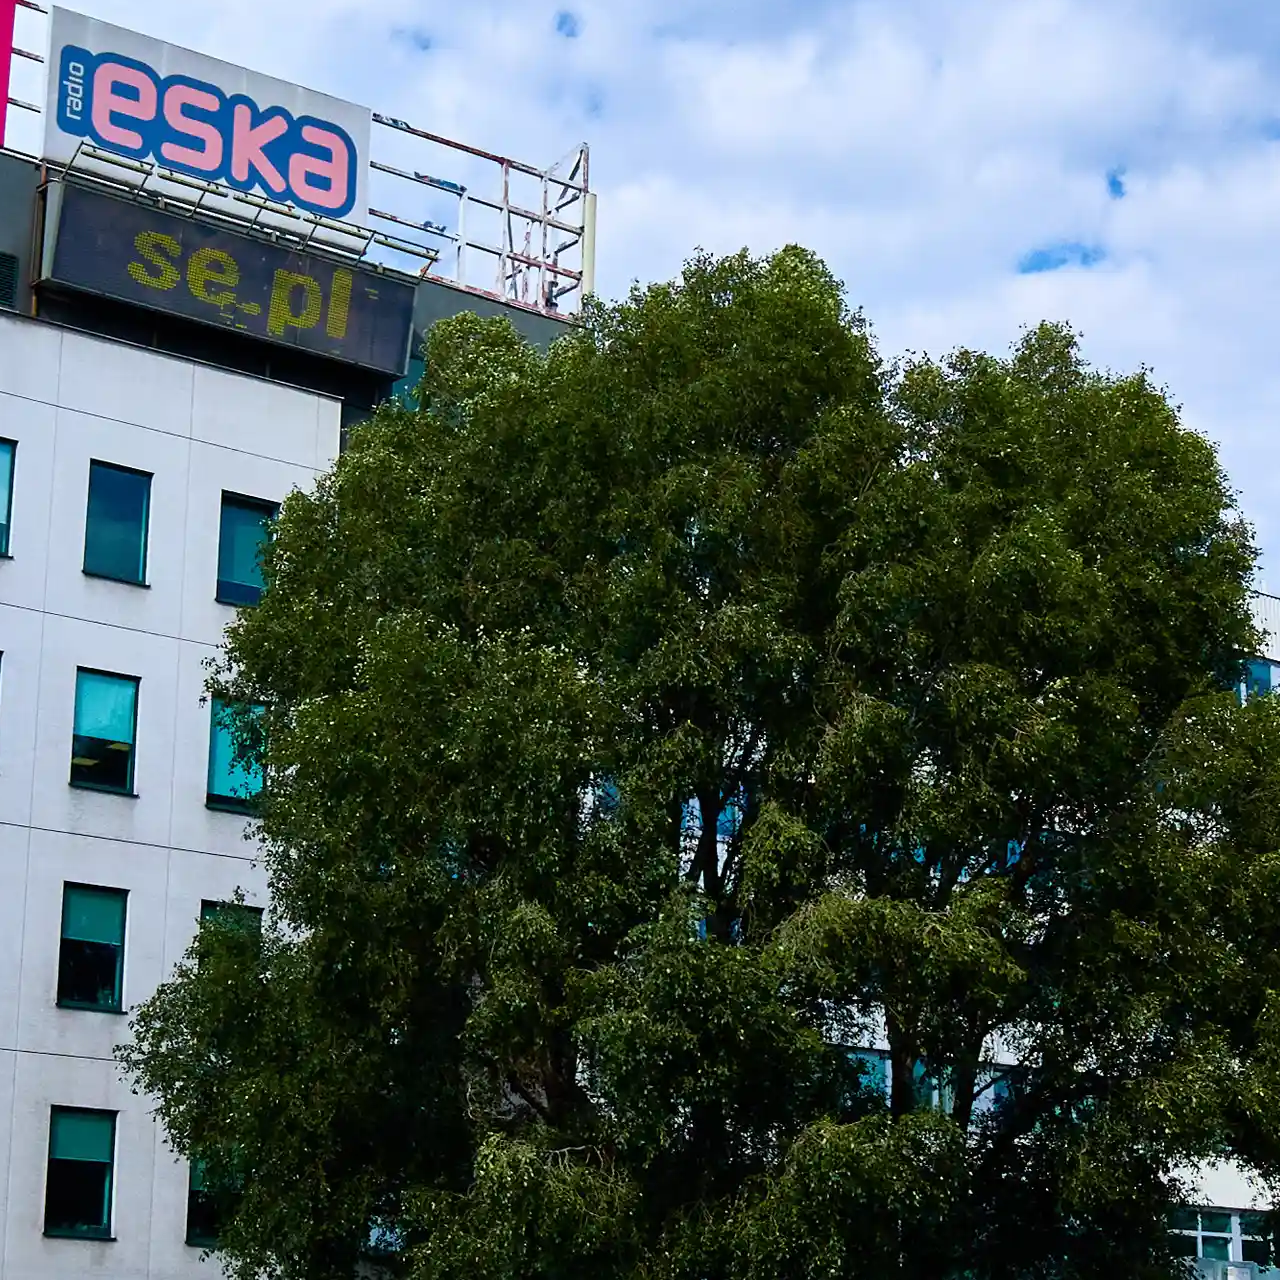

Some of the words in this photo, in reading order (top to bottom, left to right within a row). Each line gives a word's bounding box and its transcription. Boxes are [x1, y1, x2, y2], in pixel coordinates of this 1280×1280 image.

[65, 61, 84, 120] radio
[91, 62, 350, 209] eska
[127, 230, 353, 339] se.pl
